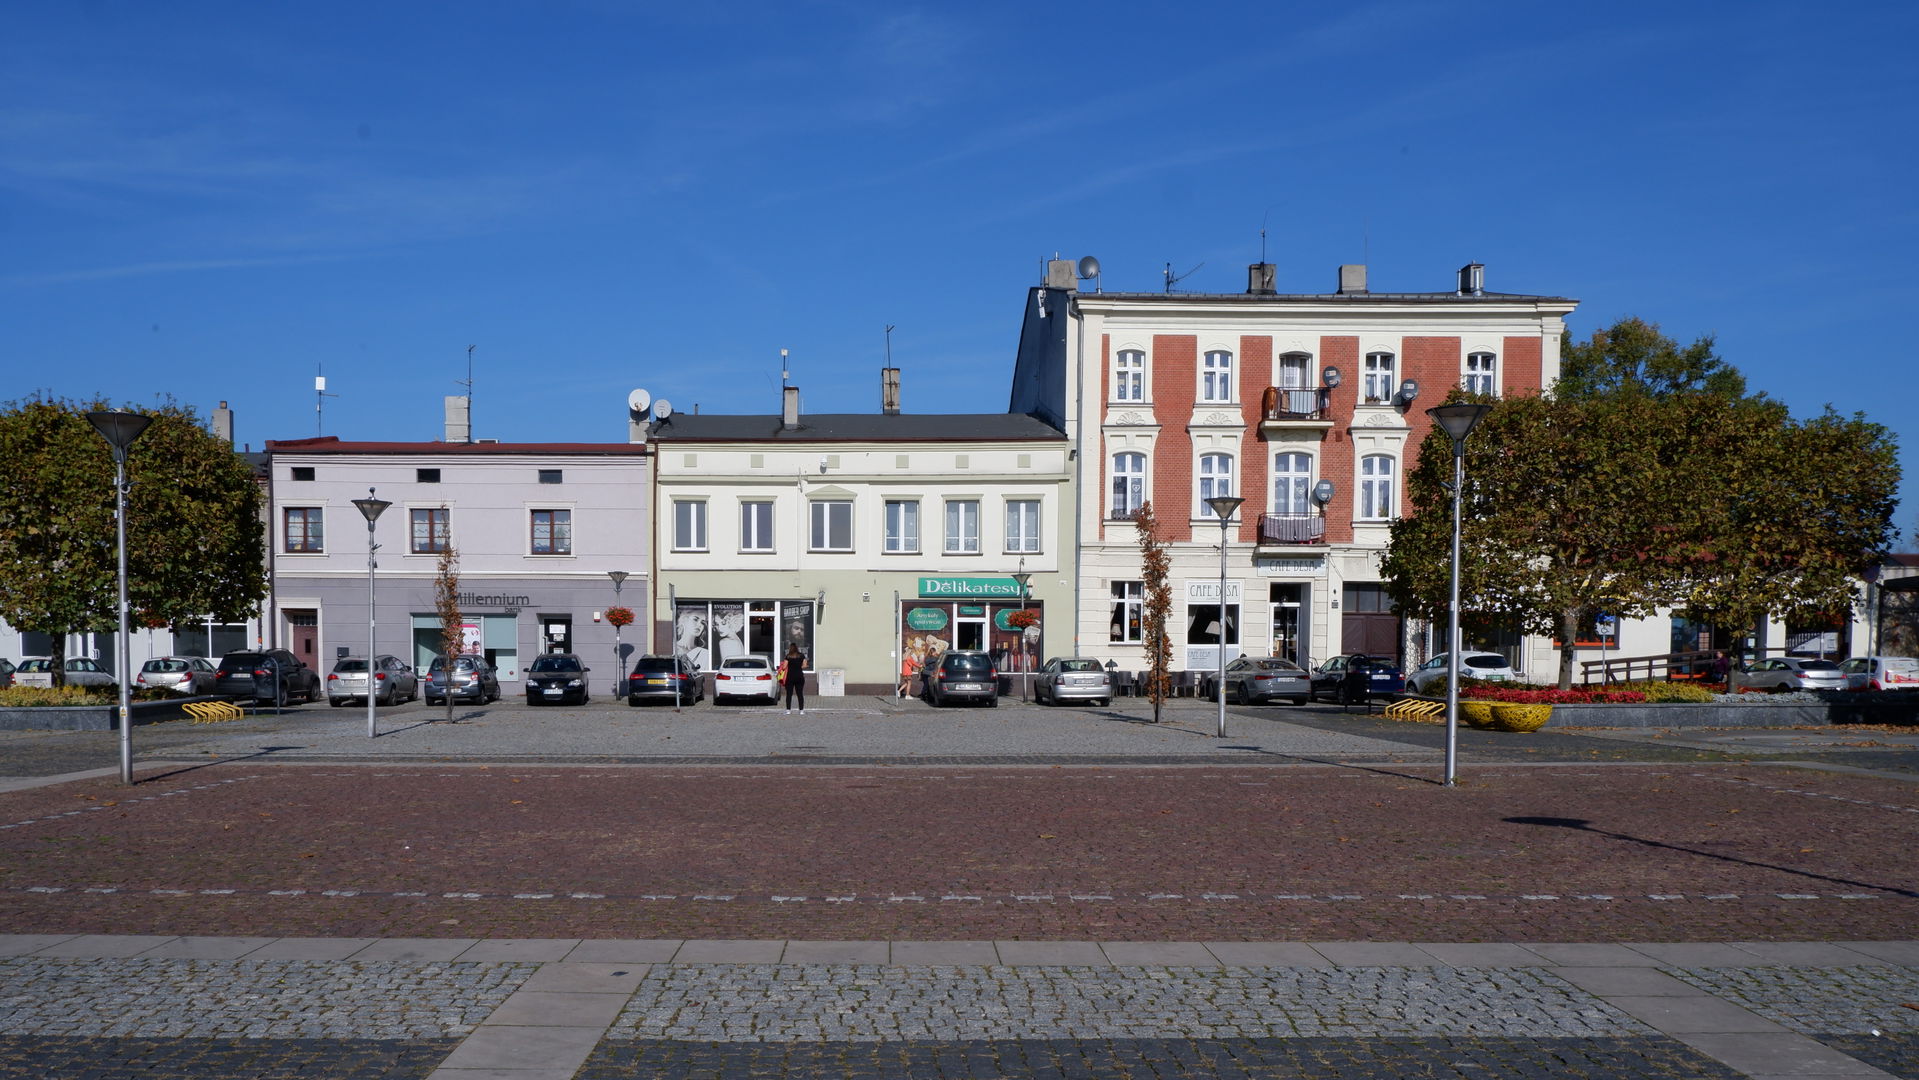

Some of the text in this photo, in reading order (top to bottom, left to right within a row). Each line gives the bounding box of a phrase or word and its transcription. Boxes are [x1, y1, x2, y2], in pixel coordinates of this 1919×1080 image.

[1269, 560, 1315, 571] CAFE DESA
[925, 580, 1020, 595] Delikatesy
[1190, 585, 1238, 596] CAFE DSA
[784, 606, 810, 617] BARBER SHOP
